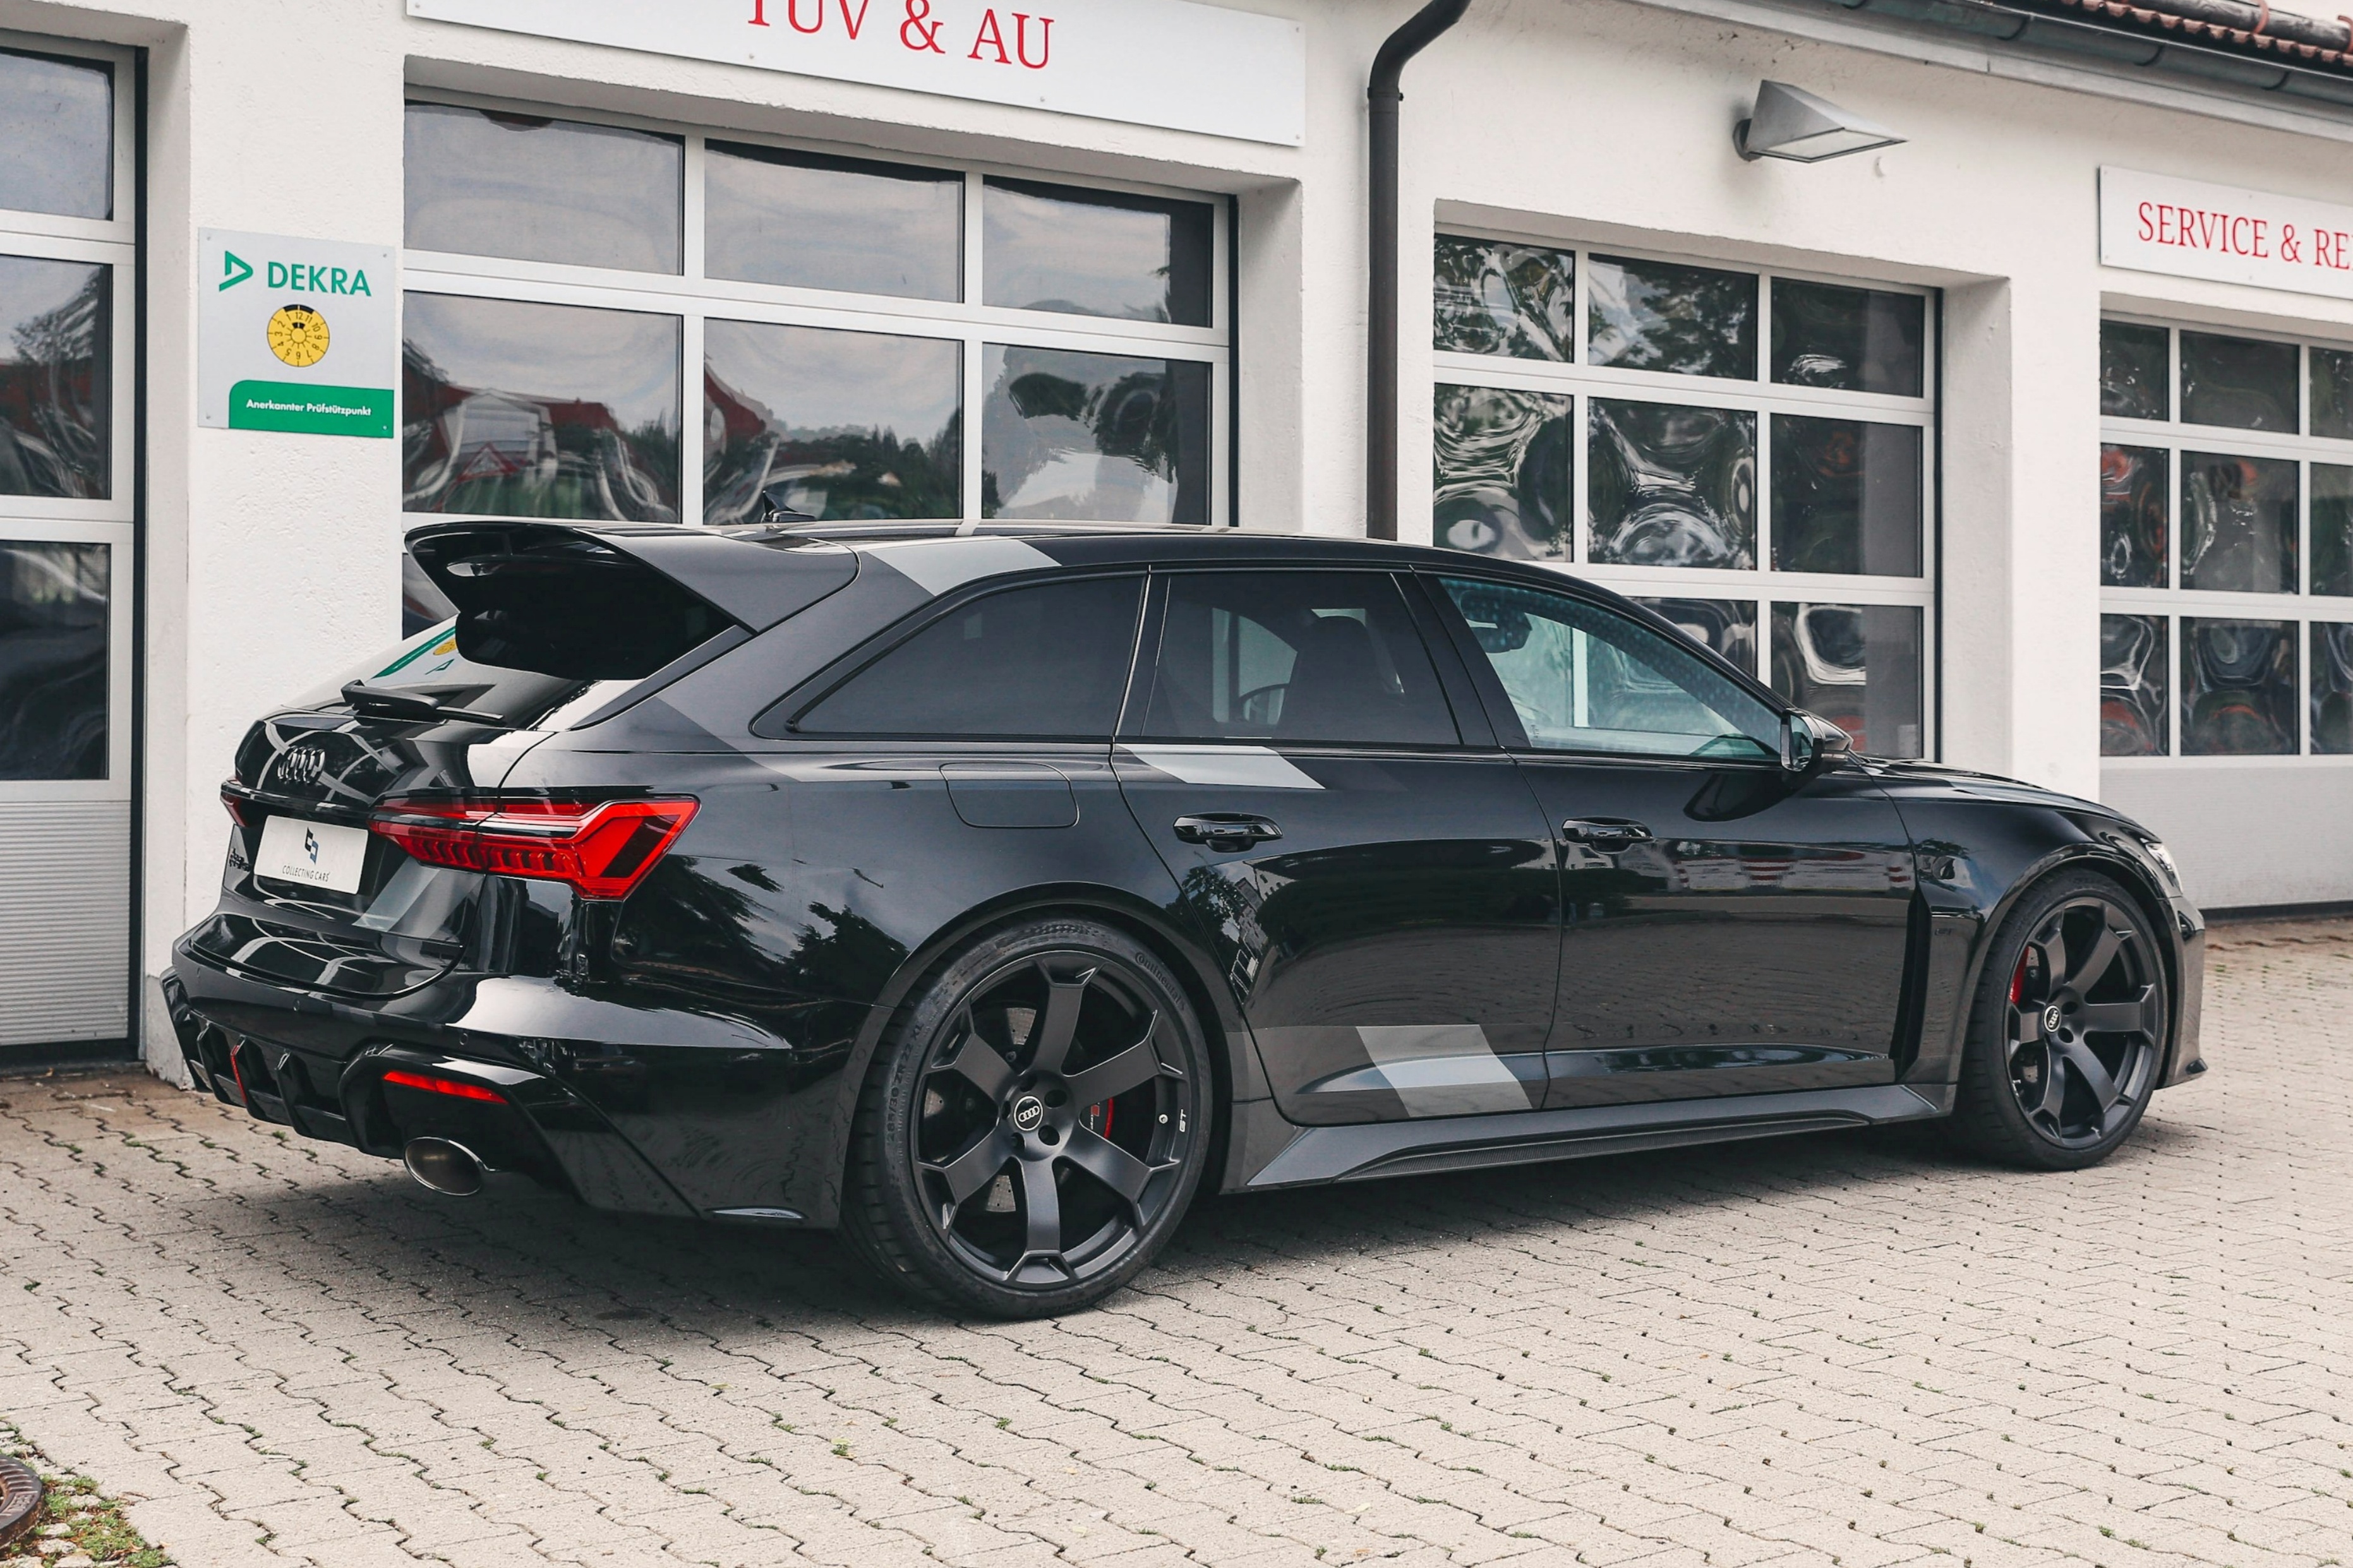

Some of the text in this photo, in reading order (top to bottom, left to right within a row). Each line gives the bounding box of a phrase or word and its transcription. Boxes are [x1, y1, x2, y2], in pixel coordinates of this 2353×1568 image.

[900, 0, 945, 54] &
[967, 9, 1054, 69] AU
[2138, 201, 2353, 270] SERVICE & RE
[268, 261, 371, 297] DEKRA
[295, 311, 303, 320] 12
[246, 398, 371, 417] Anerkannter Prüfstützpunkt
[282, 865, 329, 882] COLLECTING CARS
[1134, 952, 1182, 1005] Continental
